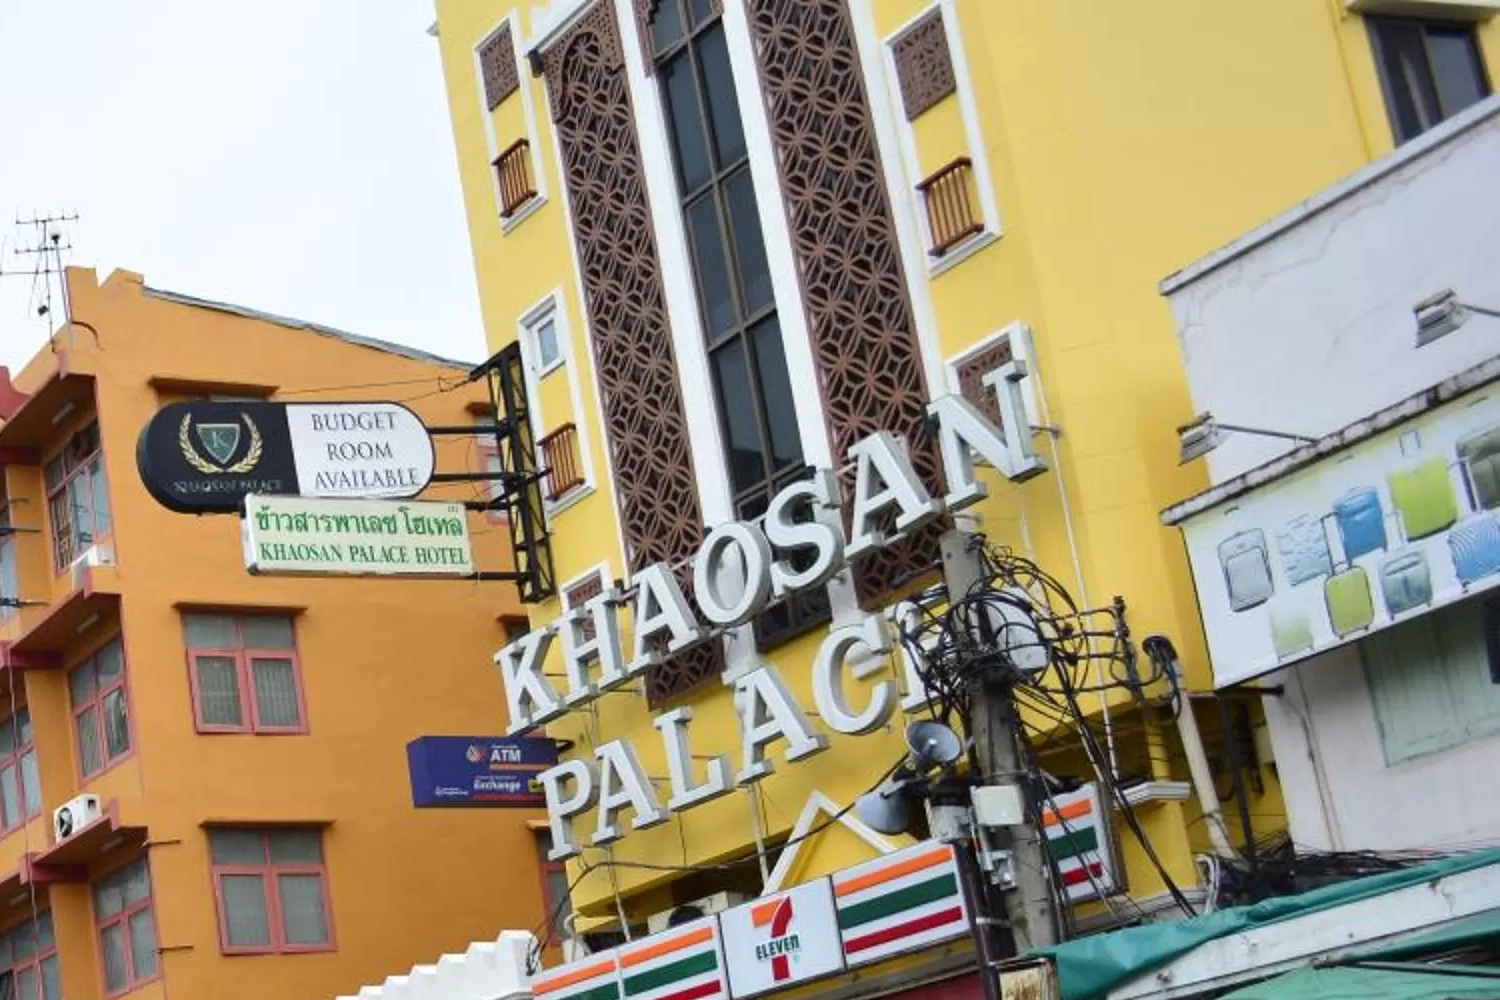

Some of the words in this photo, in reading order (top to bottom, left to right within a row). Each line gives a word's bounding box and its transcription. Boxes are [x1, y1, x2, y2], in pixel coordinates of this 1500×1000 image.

[311, 411, 397, 433] BUDGET
[327, 441, 394, 461] ROOM
[314, 466, 420, 489] AVAILABLE
[260, 543, 341, 562] KHAOSAN
[349, 545, 409, 563] PALACE
[415, 547, 468, 564] HOTEL
[494, 359, 1048, 737] KHAOSAN
[490, 749, 521, 763] ATM
[473, 779, 521, 793] Exchange
